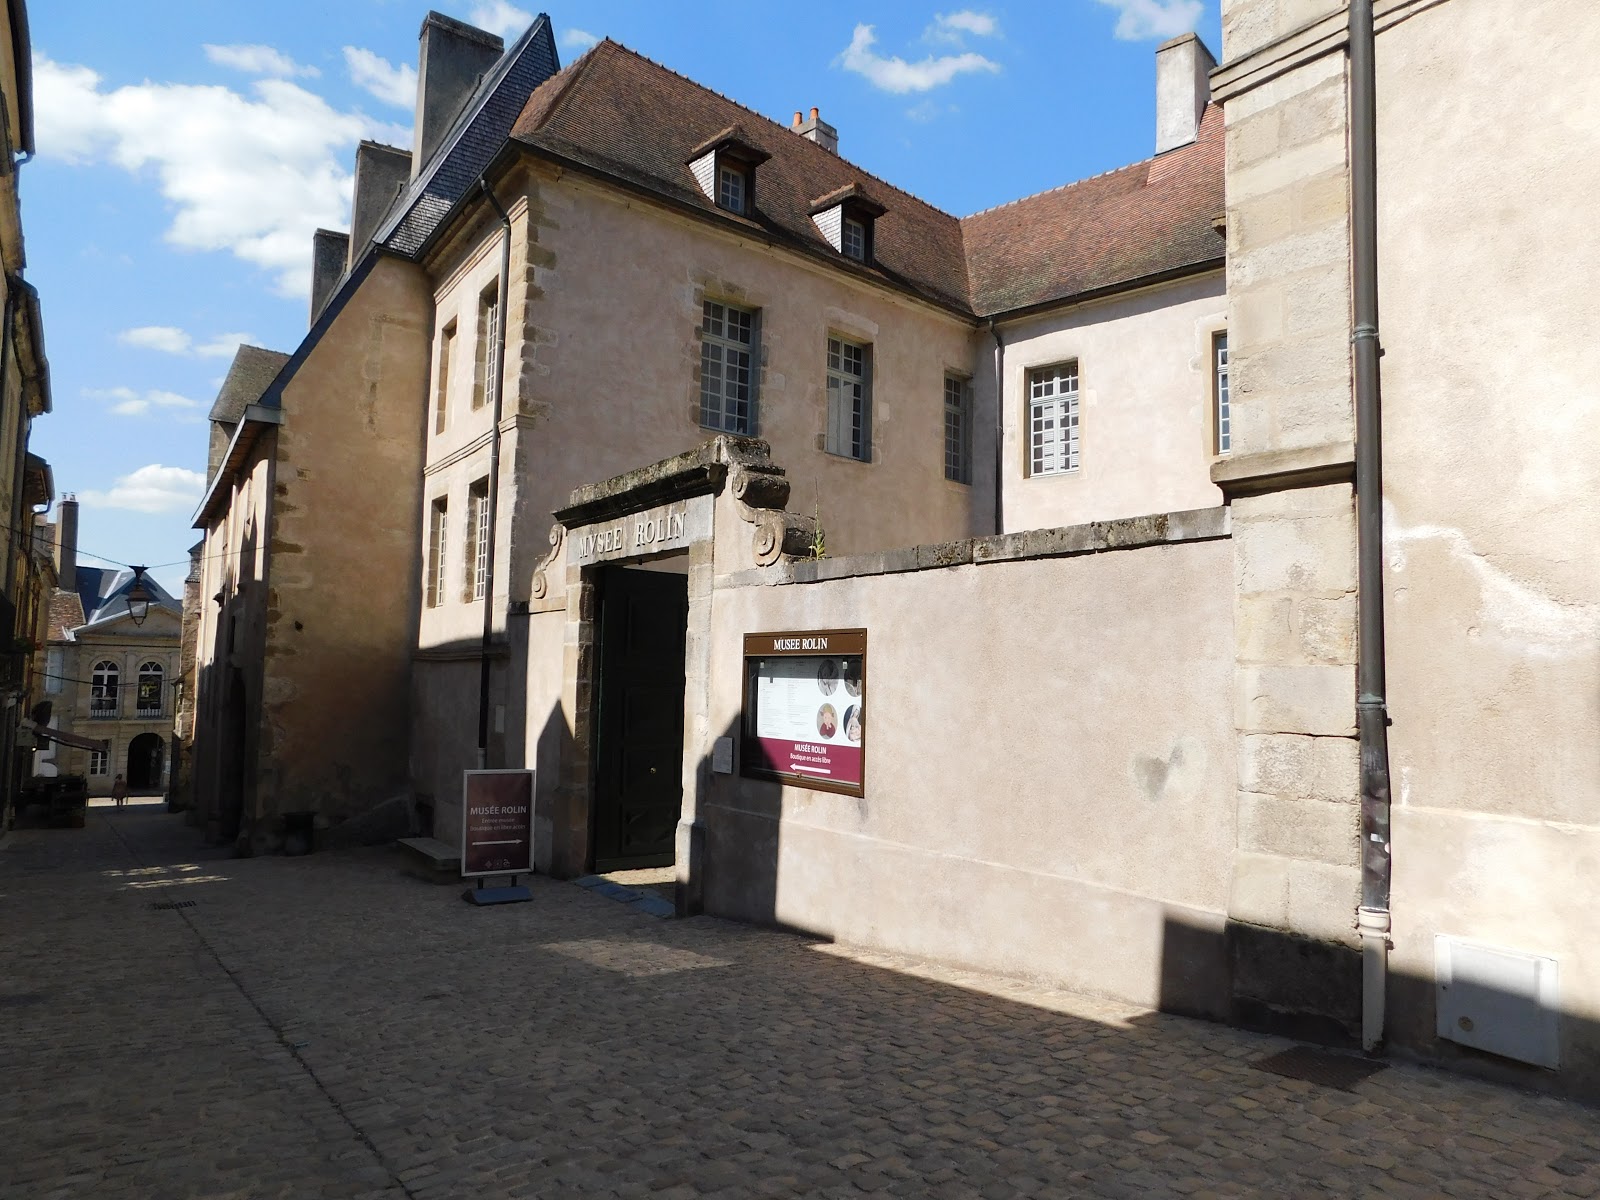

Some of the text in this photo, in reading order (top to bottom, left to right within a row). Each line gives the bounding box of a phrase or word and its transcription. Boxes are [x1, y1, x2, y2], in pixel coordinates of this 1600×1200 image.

[636, 512, 687, 547] ROLIN
[773, 637, 828, 650] MUSEE ROLIN
[794, 743, 827, 755] MUSÉE ROLIN
[790, 753, 806, 762] Boutique
[822, 756, 831, 764] libre
[470, 805, 527, 815] MUSÉE ROLIN
